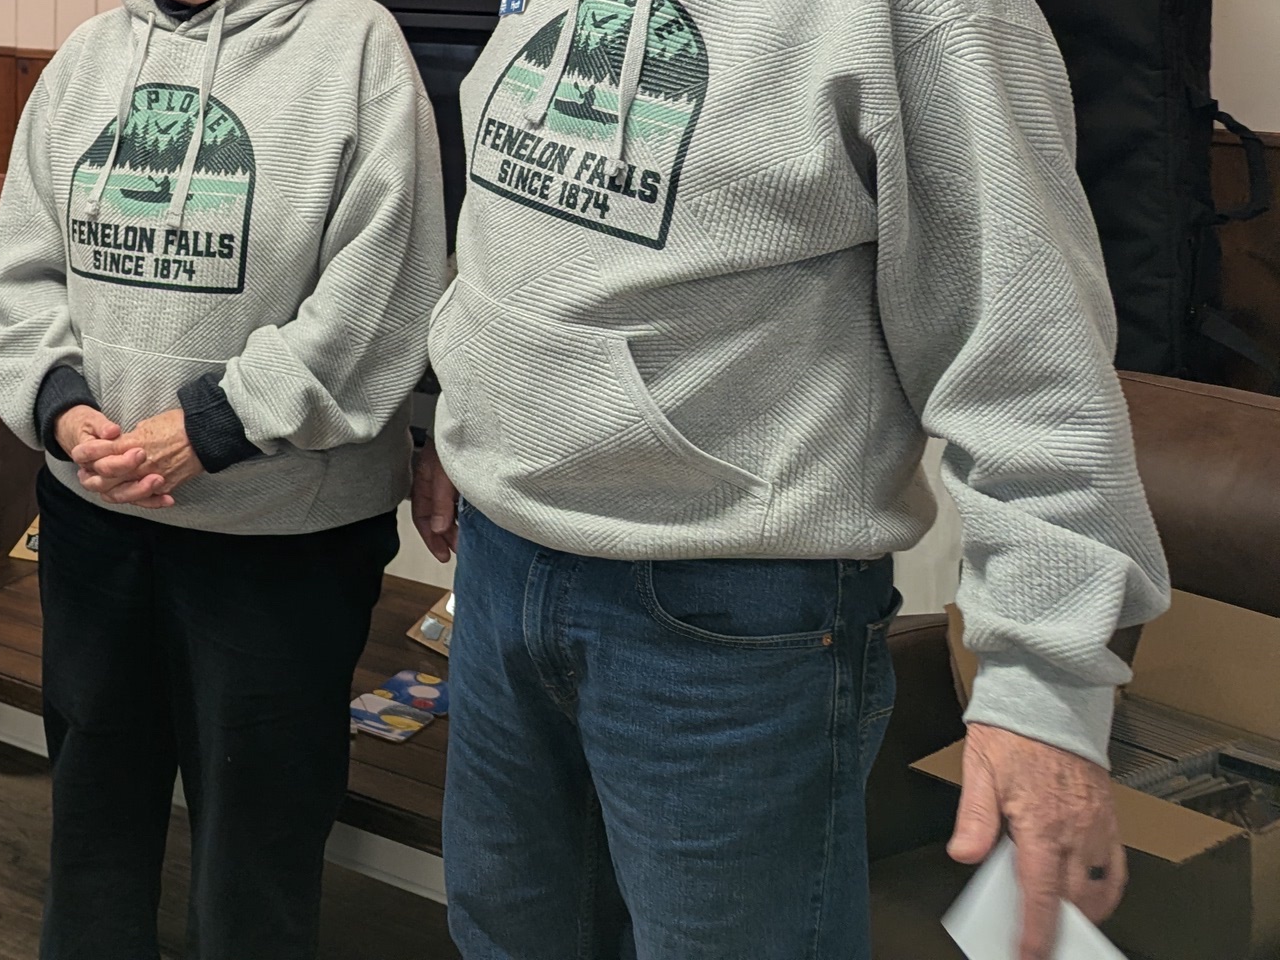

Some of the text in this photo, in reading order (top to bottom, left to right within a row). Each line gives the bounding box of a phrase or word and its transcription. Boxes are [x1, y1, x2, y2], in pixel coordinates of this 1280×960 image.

[480, 117, 576, 176] FENELON
[497, 159, 611, 220] SINCE 1874
[71, 219, 236, 259] FENELON FALLS
[92, 250, 196, 282] SINCE 1874
